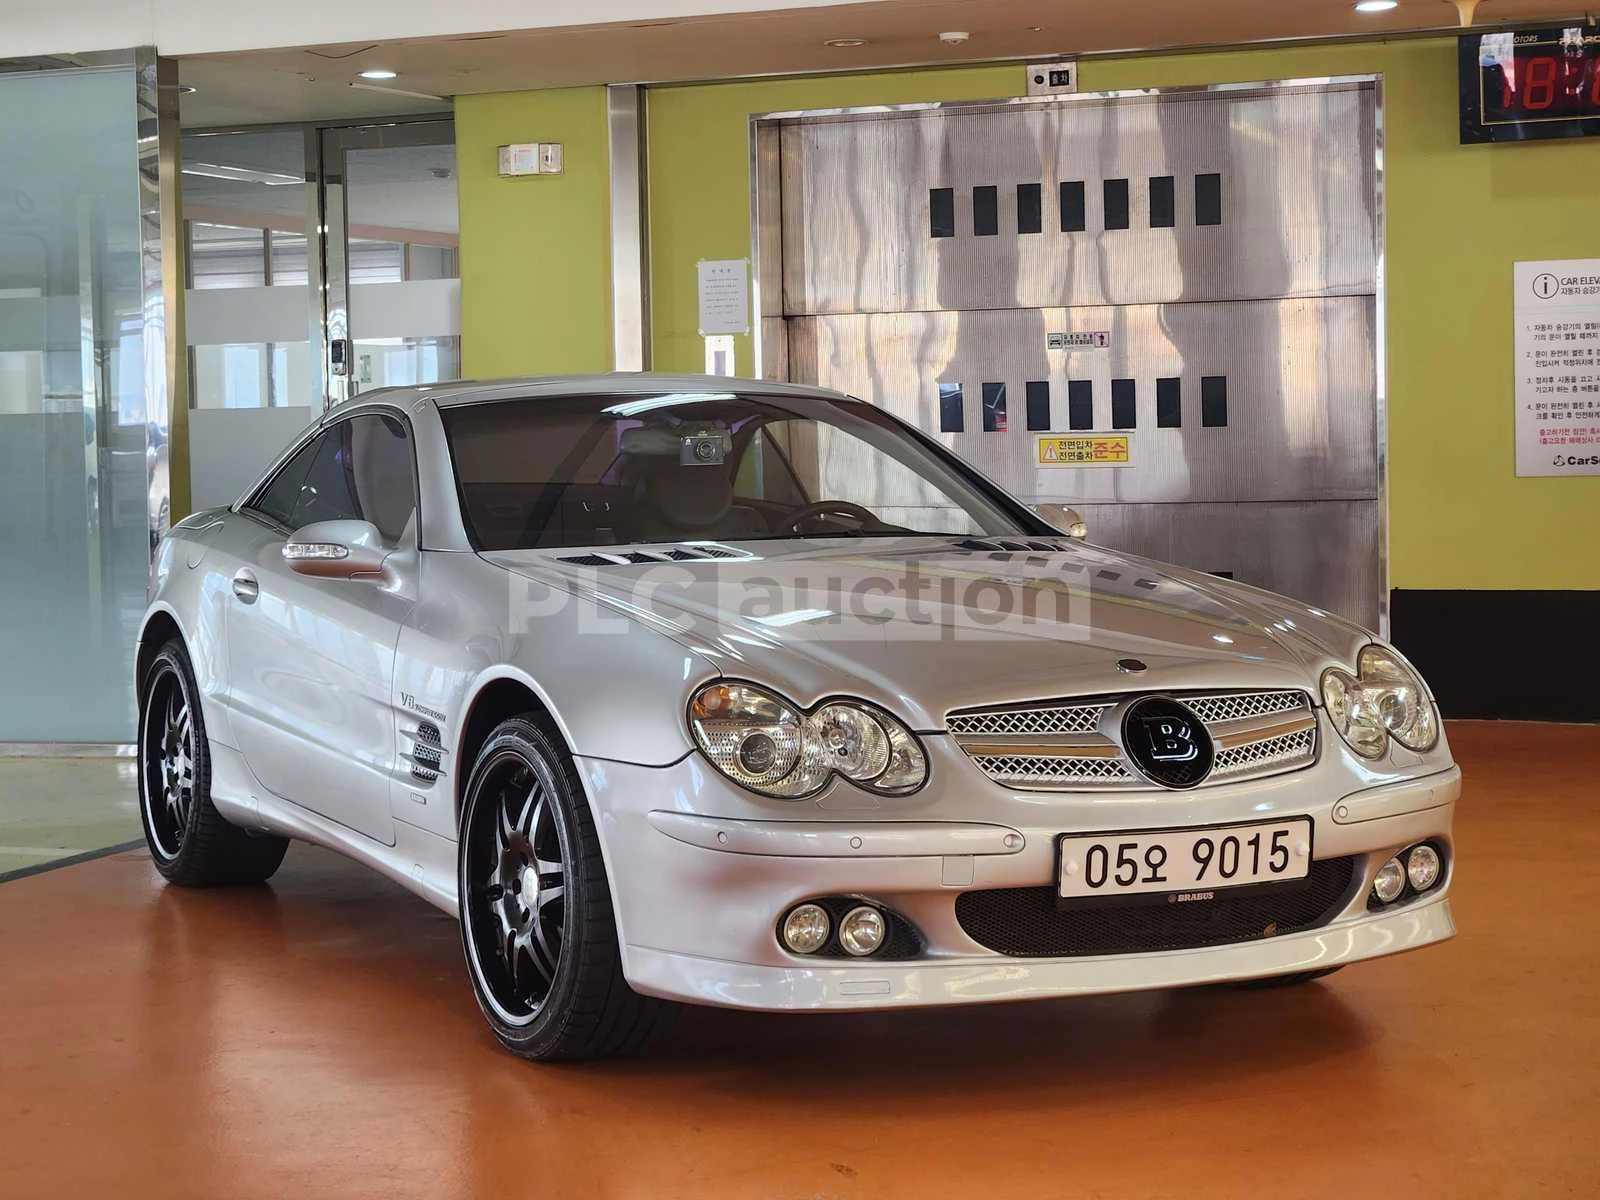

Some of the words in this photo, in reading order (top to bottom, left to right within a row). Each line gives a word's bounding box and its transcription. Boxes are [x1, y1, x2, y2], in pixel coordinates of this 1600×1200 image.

[1560, 277, 1578, 286] CAR
[1580, 276, 1600, 285] ELEV
[1561, 287, 1581, 295] 자동차
[1059, 440, 1093, 450] 전면입차
[1093, 442, 1125, 459] 준수
[1059, 451, 1093, 461] 전면출차
[1567, 455, 1600, 466] CarS
[1085, 843, 1167, 888] 05오
[1192, 830, 1289, 881] 9015
[1177, 891, 1215, 902] BRABUS
